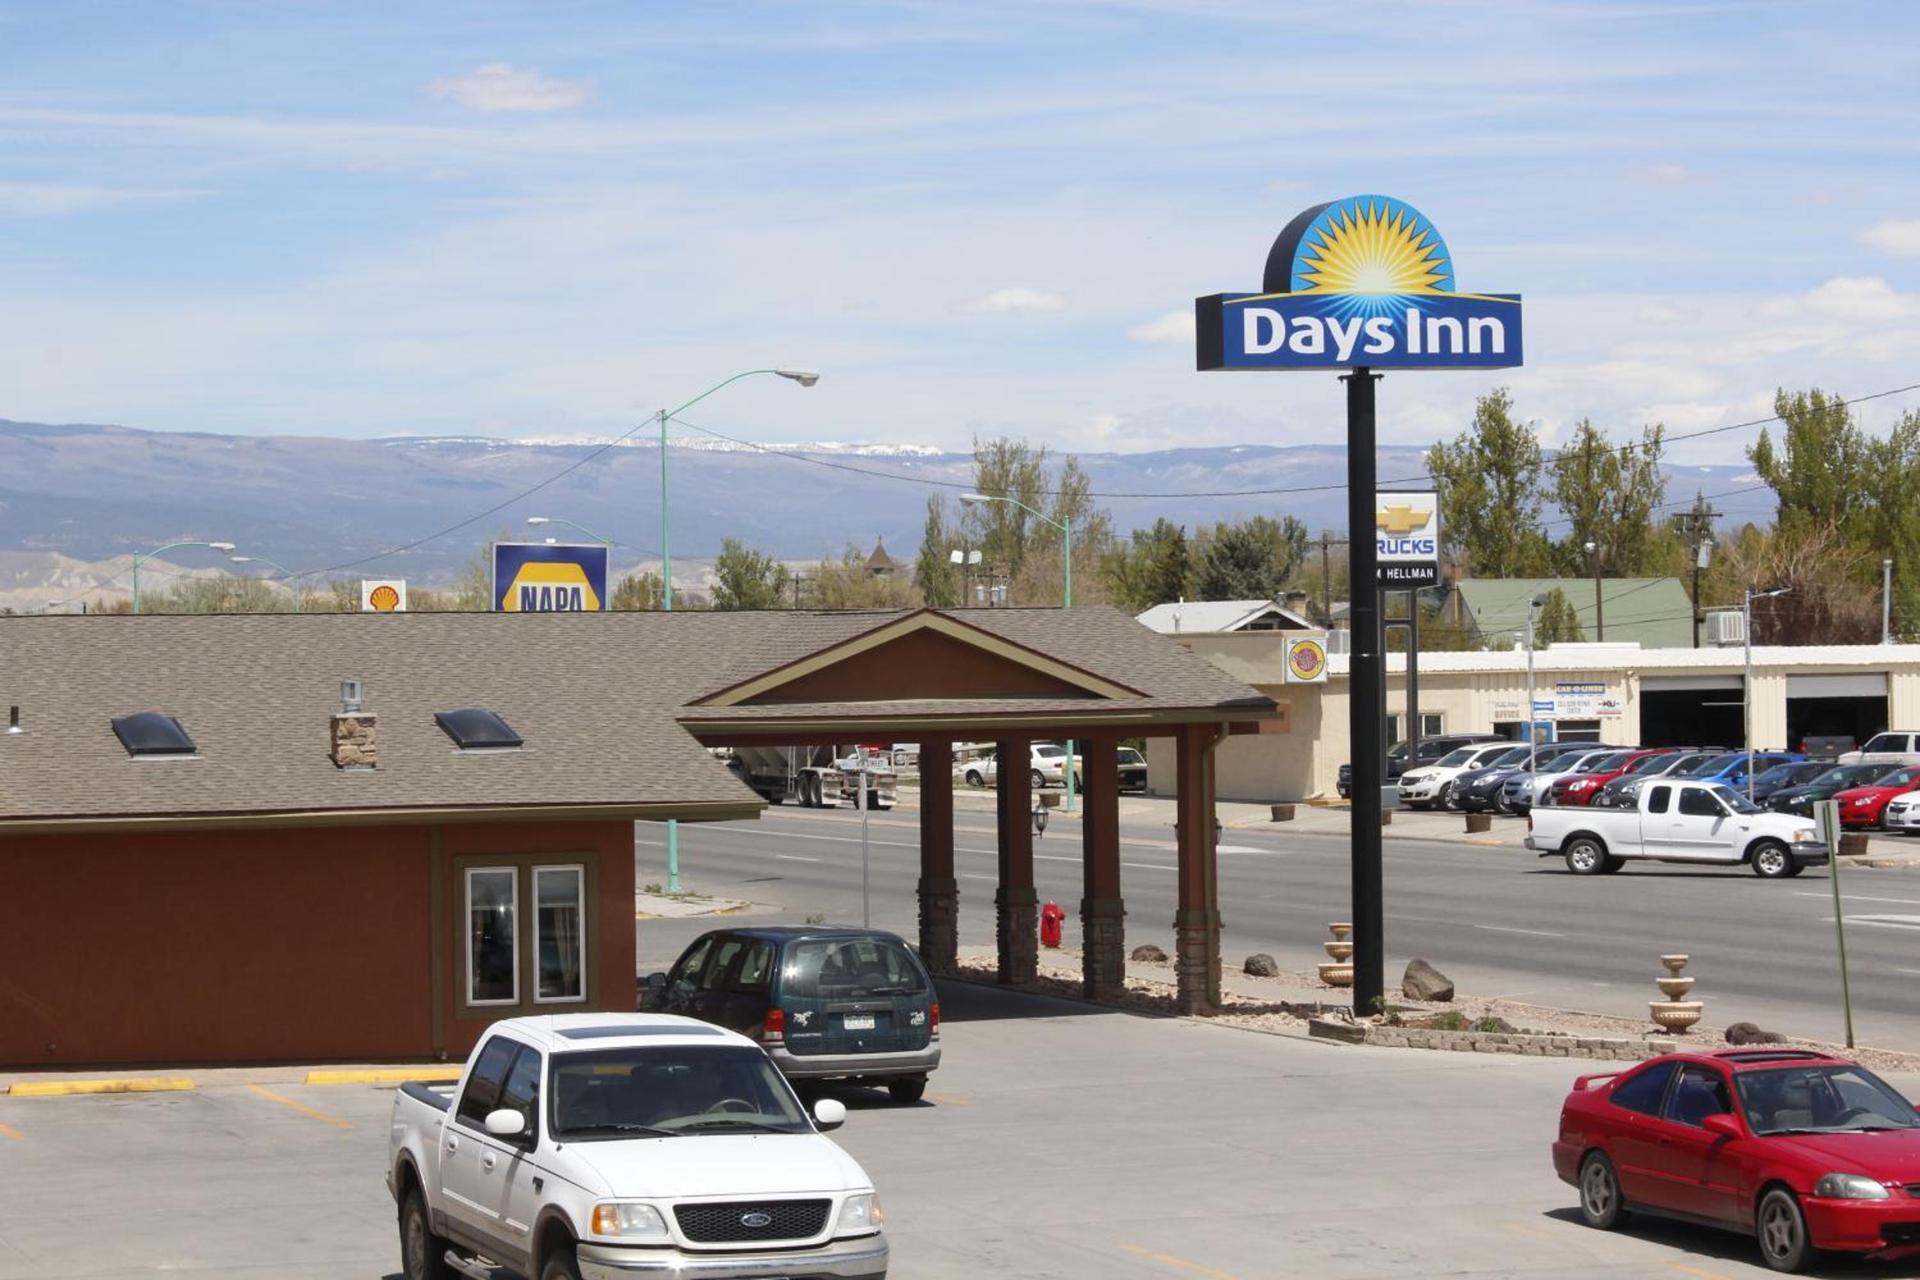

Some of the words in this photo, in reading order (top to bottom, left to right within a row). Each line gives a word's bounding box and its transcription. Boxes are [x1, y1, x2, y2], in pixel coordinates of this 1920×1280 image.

[1243, 307, 1396, 362] Days
[1406, 307, 1505, 354] Inn
[1376, 540, 1434, 554] RUCKS
[1387, 568, 1434, 579] HELLMAN
[521, 585, 582, 611] NAPA
